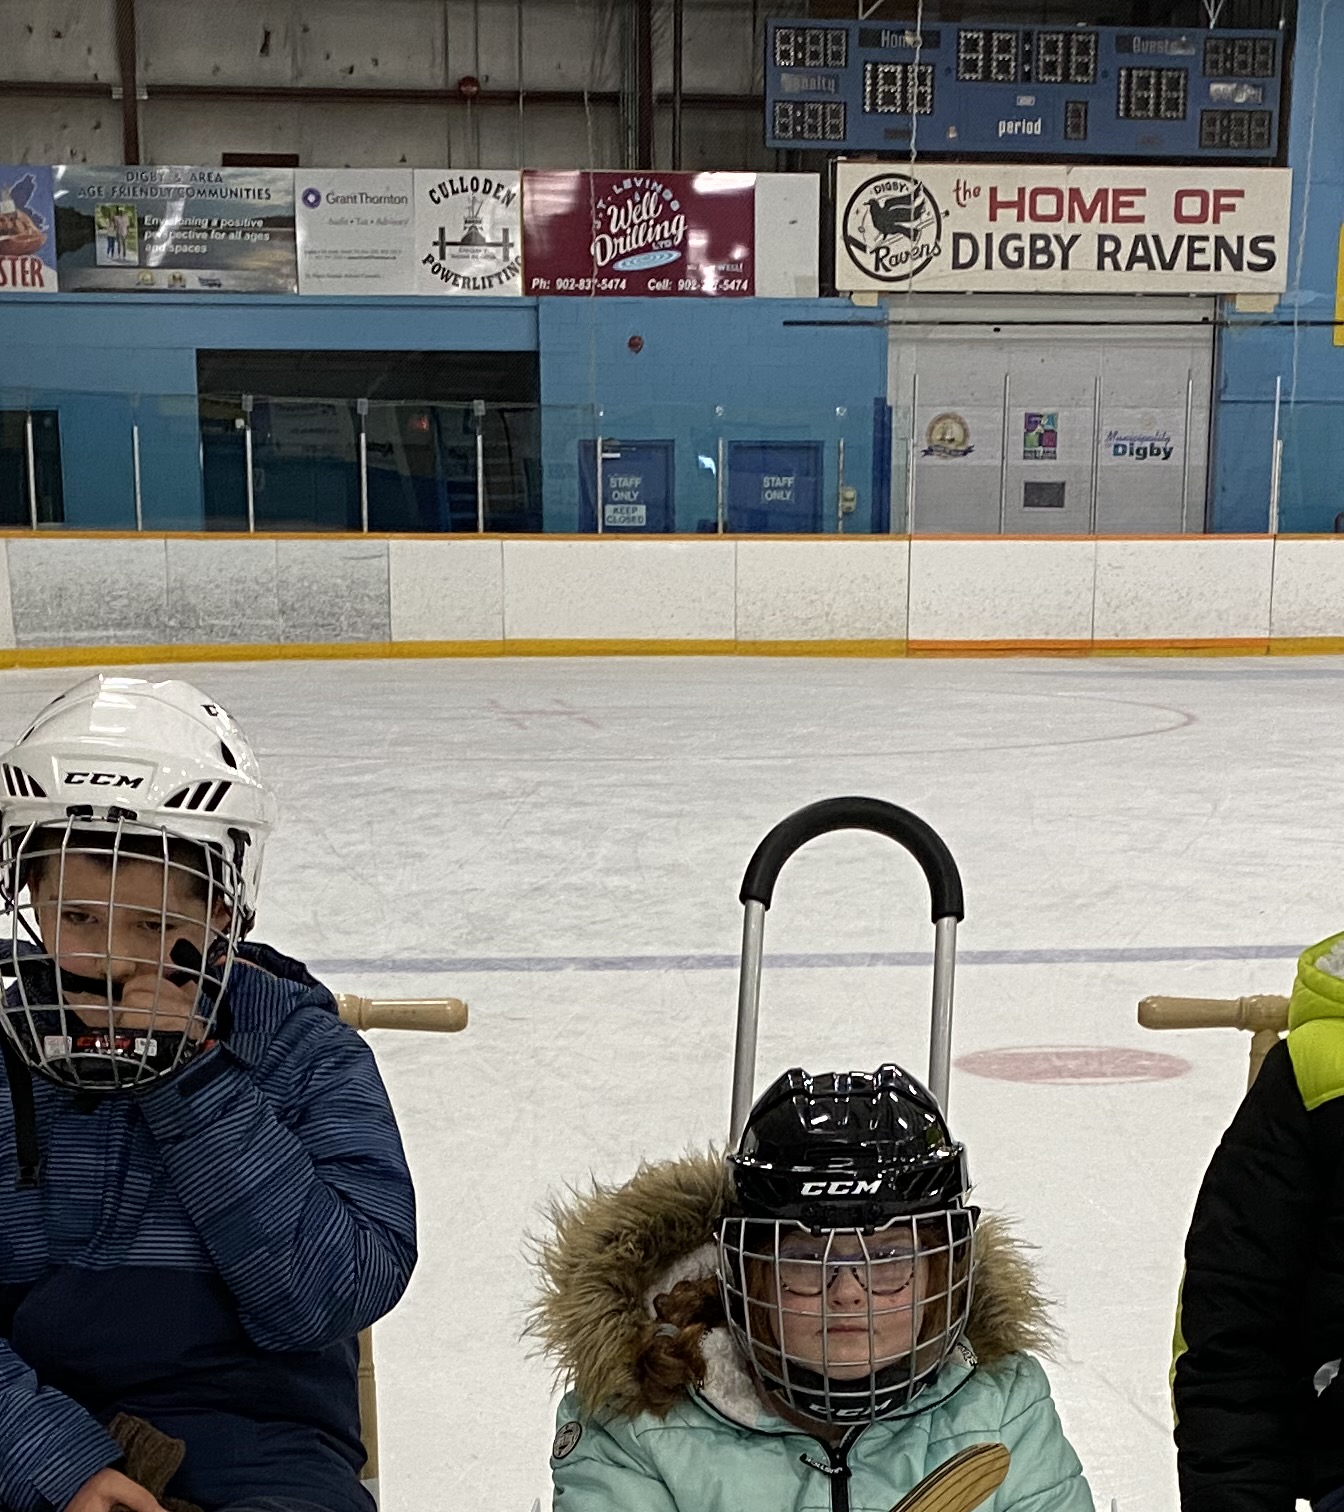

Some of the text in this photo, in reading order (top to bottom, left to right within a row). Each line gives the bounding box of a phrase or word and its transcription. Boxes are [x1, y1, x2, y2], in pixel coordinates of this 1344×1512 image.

[999, 117, 1041, 137] period
[126, 171, 164, 183] DIGBY
[190, 172, 223, 183] AREA
[78, 186, 272, 200] AGE FRIENDLY COMMUNITIES
[428, 176, 517, 208] CULLODEN
[873, 181, 907, 195] DIGBY
[326, 192, 408, 205] Grant Thornton
[953, 179, 1246, 225] the HOME OF
[607, 191, 663, 234] Well
[220, 217, 264, 229] positive
[210, 230, 226, 240] for
[590, 213, 688, 266] Drilling
[870, 242, 941, 272] Ravens
[951, 232, 1276, 273] DIGBY RAVENS
[531, 278, 551, 290] Ph:
[648, 279, 673, 291] Cell:
[1112, 442, 1174, 460] Digby
[610, 477, 641, 488] STAFF
[763, 477, 794, 488] STAFF
[612, 491, 639, 501] ONLY
[764, 491, 792, 501] ONLY
[613, 507, 637, 515] KEEP
[64, 771, 145, 789] CCM
[801, 1180, 882, 1196] CCM
